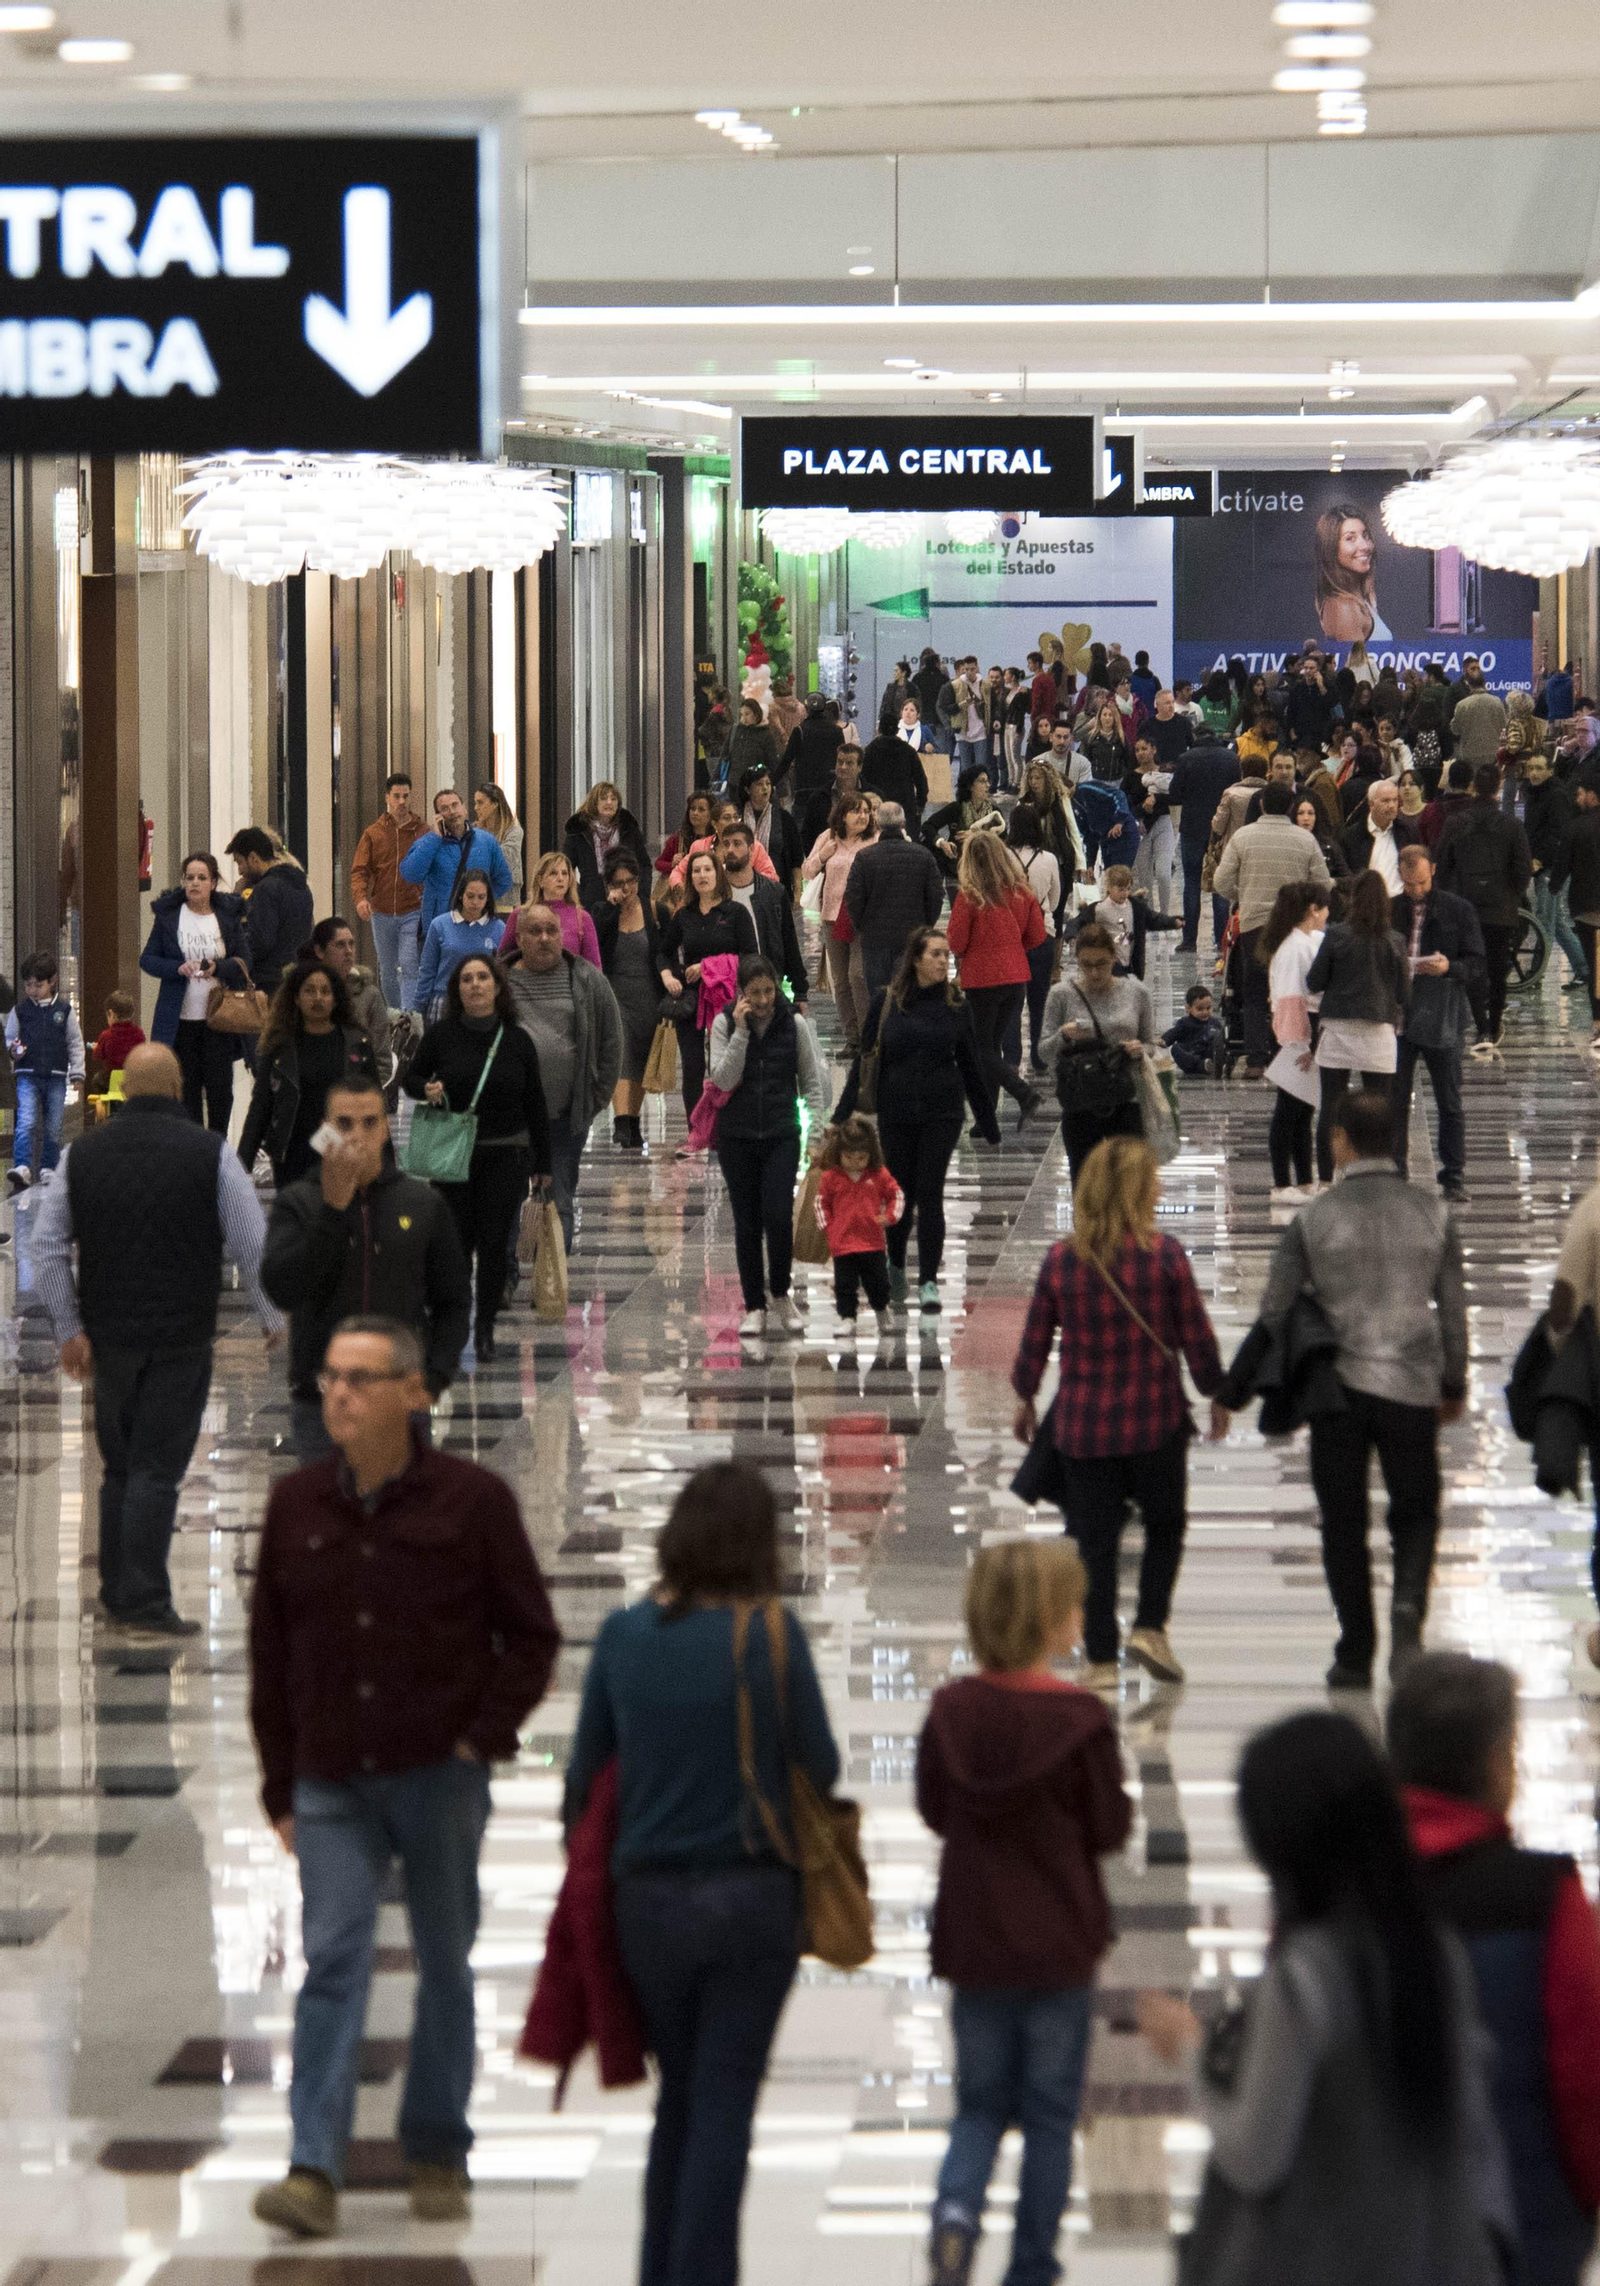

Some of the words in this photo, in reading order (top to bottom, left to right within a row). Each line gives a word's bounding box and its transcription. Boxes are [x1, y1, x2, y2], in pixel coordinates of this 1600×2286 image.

[783, 448, 889, 475] PLAZA
[899, 448, 1052, 475] CENTRAL
[1001, 542, 1010, 558] y
[1016, 539, 1094, 557] Apuestas
[966, 560, 992, 575] del
[997, 560, 1056, 575] Estado
